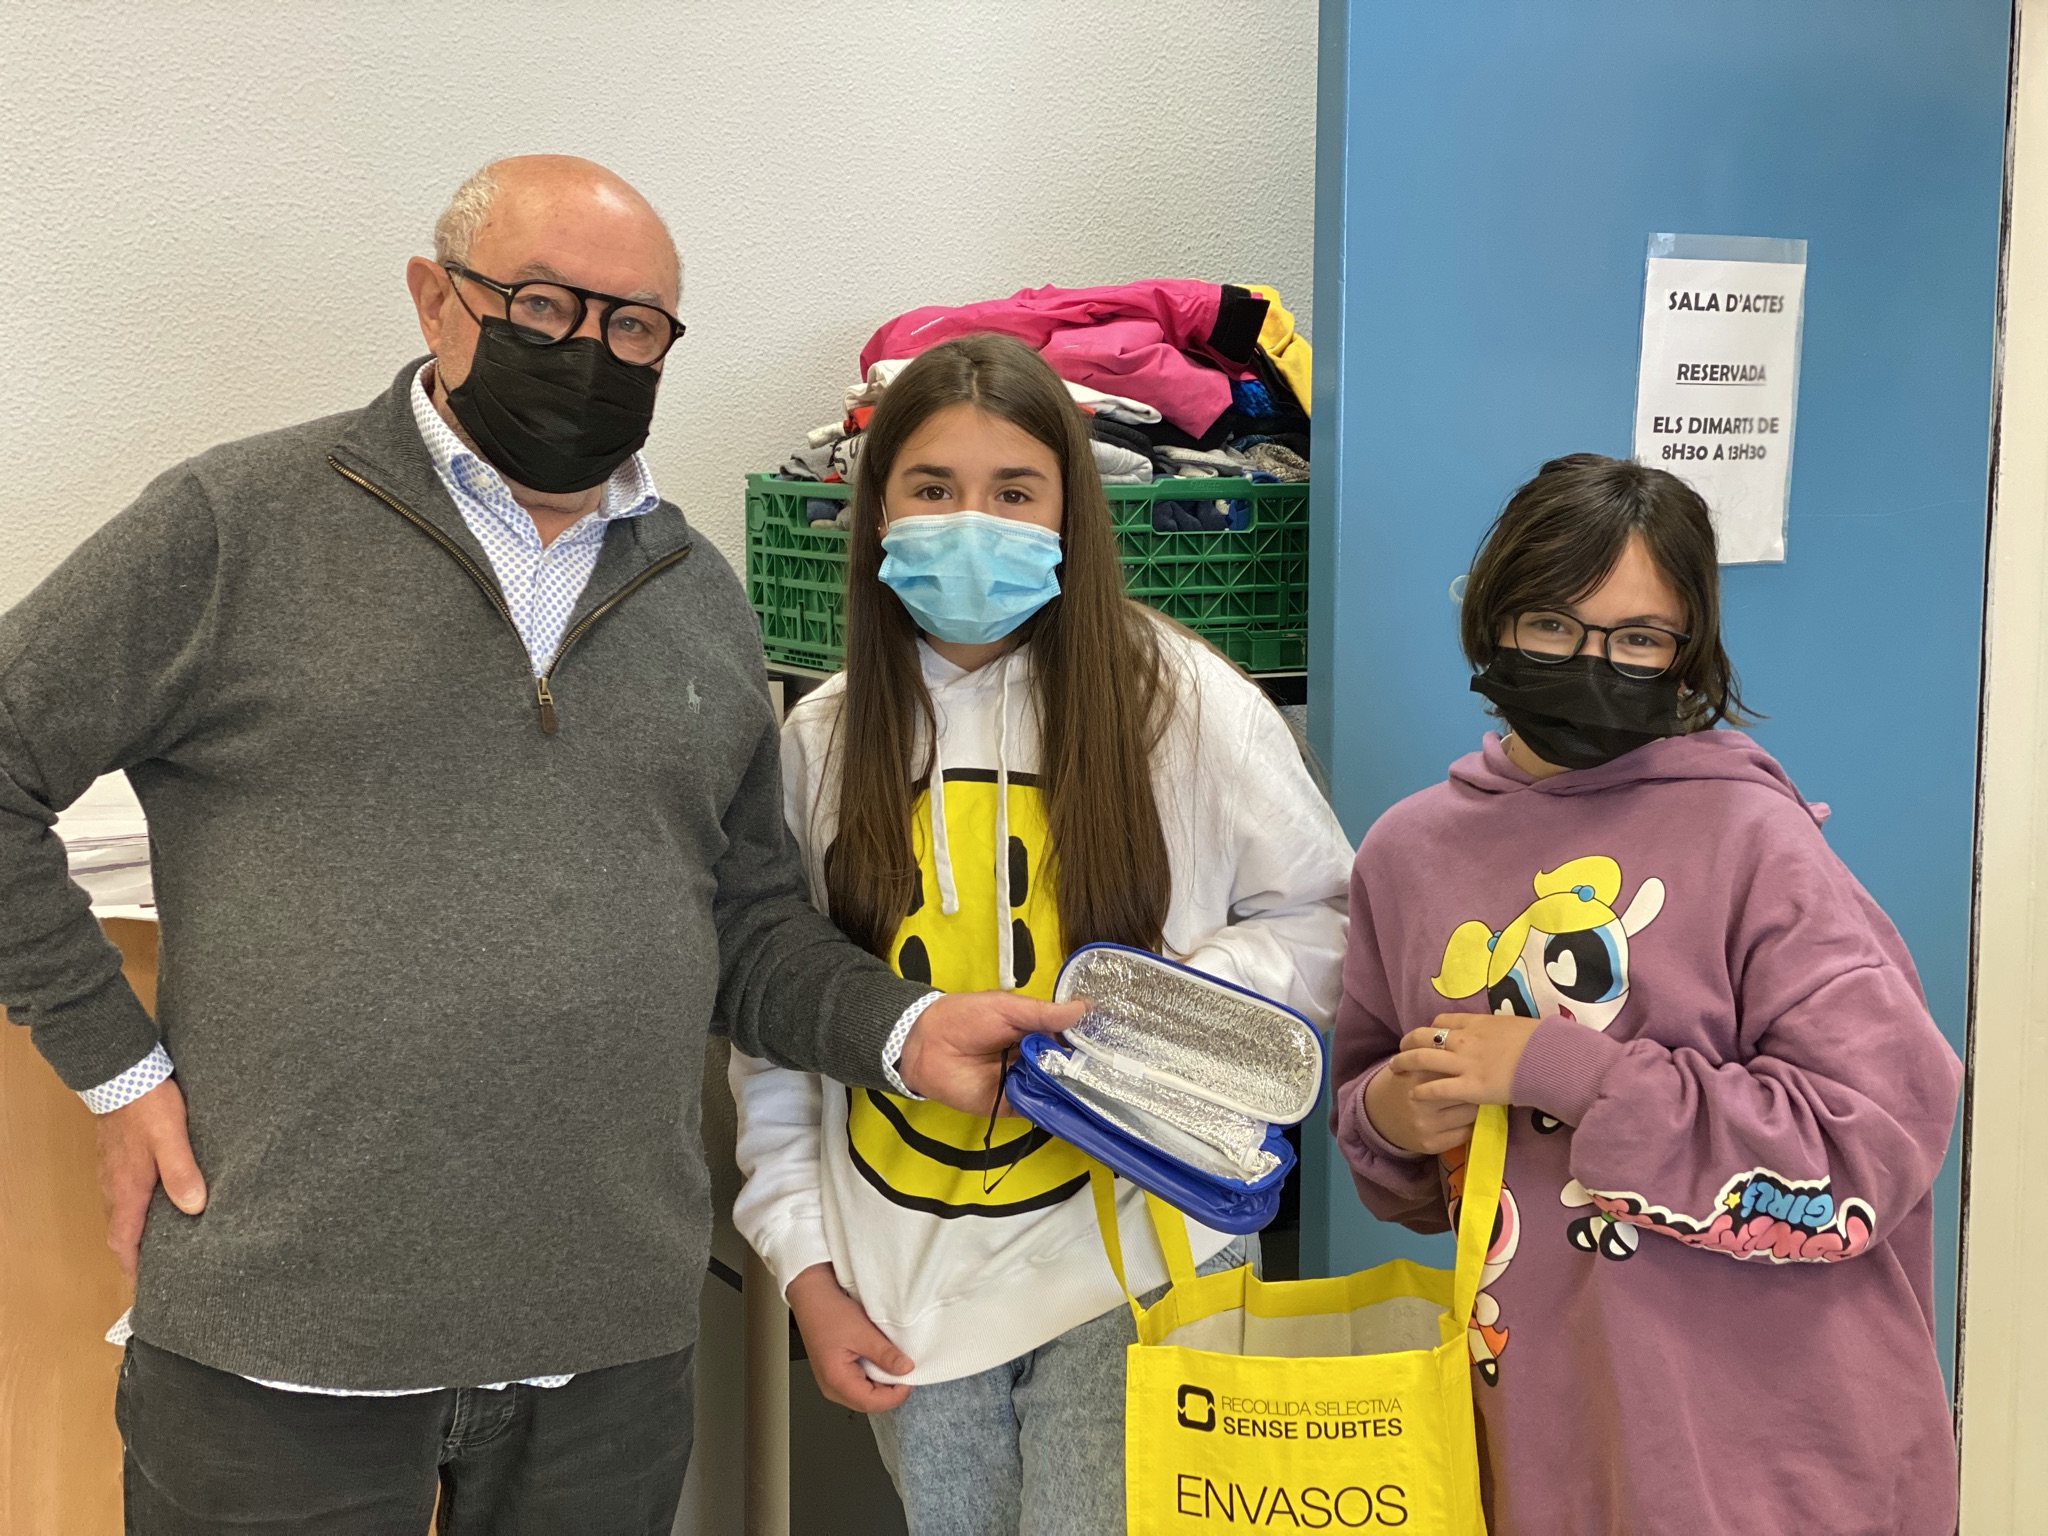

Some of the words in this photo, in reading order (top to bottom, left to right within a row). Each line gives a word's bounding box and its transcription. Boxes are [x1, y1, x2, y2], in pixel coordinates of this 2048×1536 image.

[1668, 290, 1721, 313] SALA
[1725, 293, 1785, 314] D'ACTES
[1676, 362, 1768, 383] RESERVADA
[1652, 416, 1684, 434] ELS
[1687, 417, 1755, 435] DIMARTS
[1757, 417, 1780, 435] DE
[1661, 443, 1709, 461] 8H30
[1713, 443, 1725, 461] A
[1728, 444, 1768, 461] 13H30
[1741, 1181, 1834, 1228] GIRLS
[1221, 1395, 1312, 1417] RECOLLIDA
[1314, 1398, 1403, 1417] SELECTIVA
[1223, 1416, 1299, 1440] SENSE
[1306, 1417, 1403, 1440] DUBTES
[1177, 1472, 1408, 1529] ENVASOS
